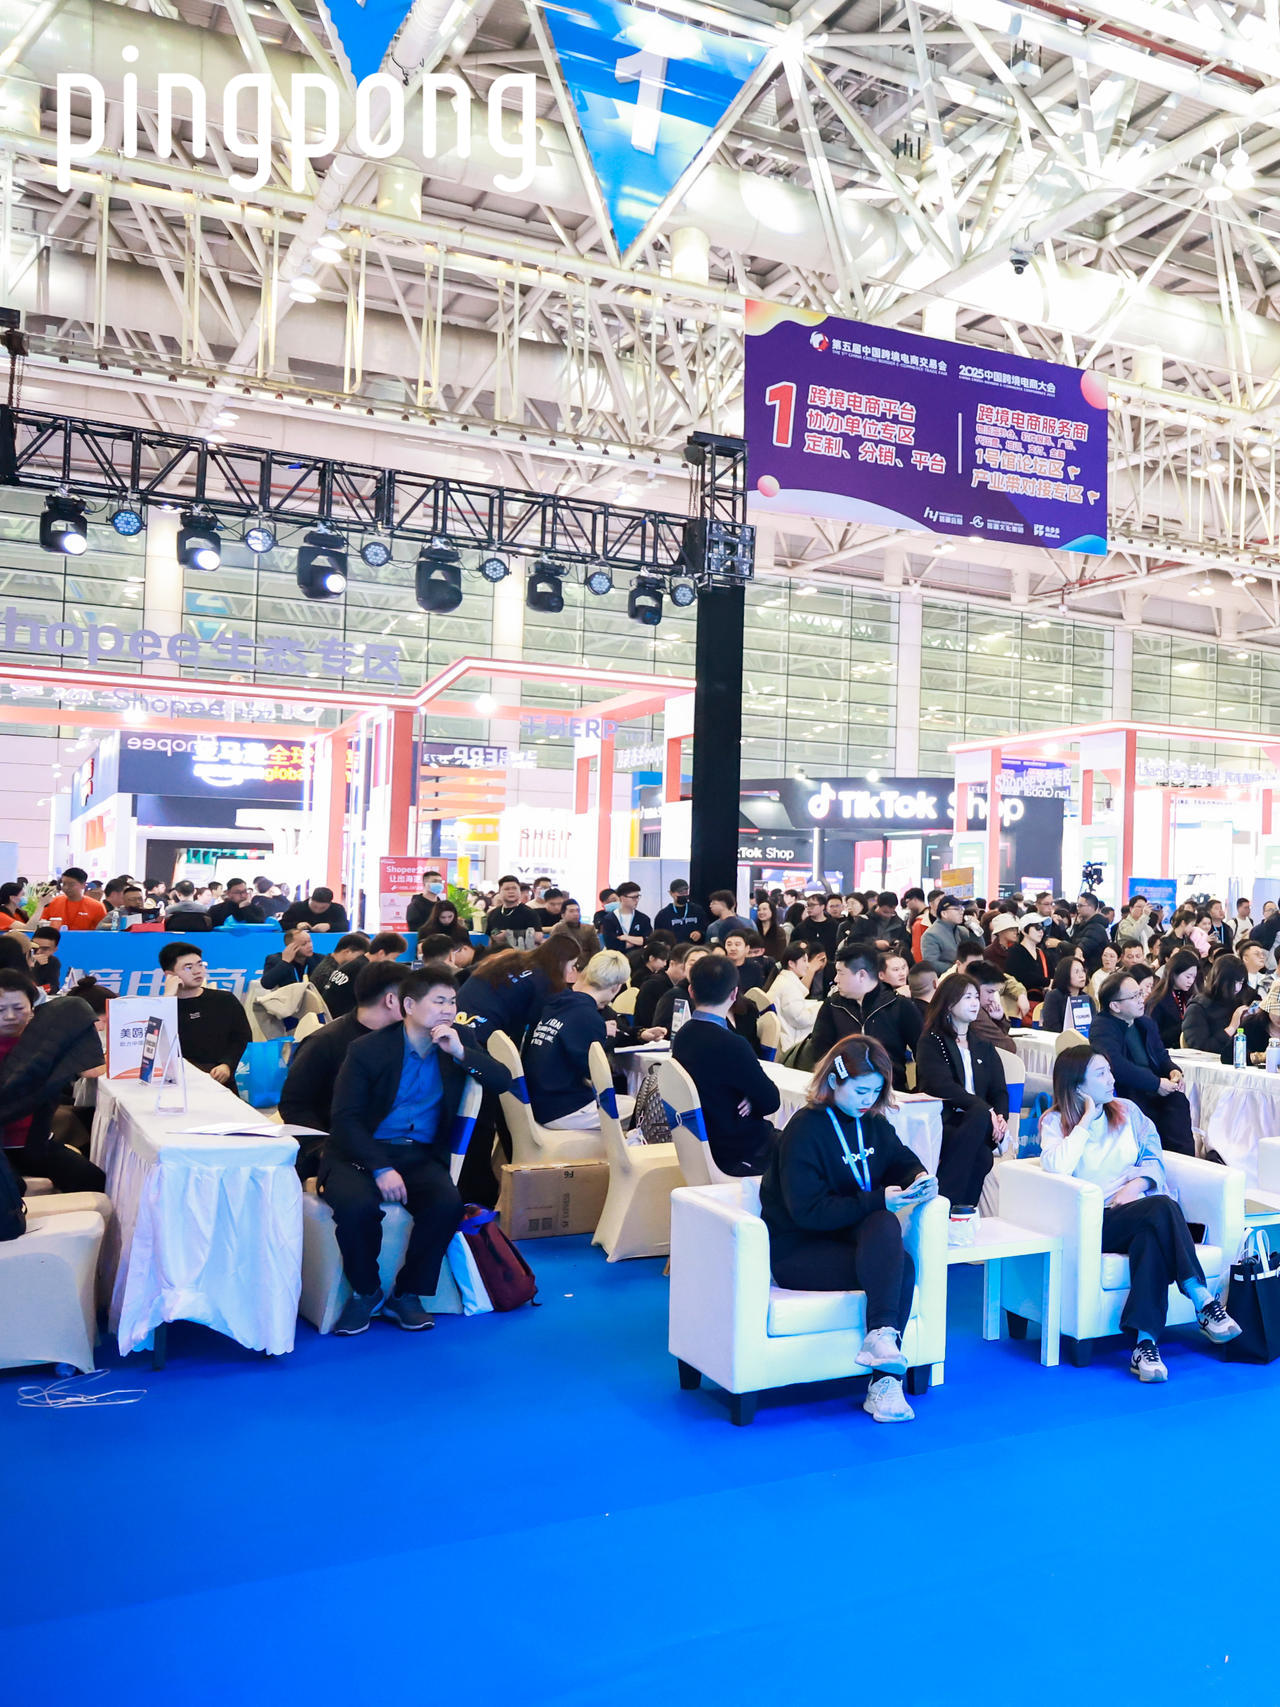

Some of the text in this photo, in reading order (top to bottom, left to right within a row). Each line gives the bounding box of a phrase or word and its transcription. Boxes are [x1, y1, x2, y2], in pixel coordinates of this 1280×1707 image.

[615, 43, 668, 155] 1
[765, 381, 796, 448] 1
[808, 385, 916, 423] 跨境电商平台
[976, 403, 1089, 442] 跨境电商服务商
[806, 408, 915, 446] 协办单位专区
[803, 432, 947, 474] 定制、分销、平台
[975, 447, 1064, 479] 1号馆论坛区
[971, 468, 1083, 504] 产业带对接专区
[837, 790, 1025, 827] TikTok Shp
[766, 847, 795, 862] Shop
